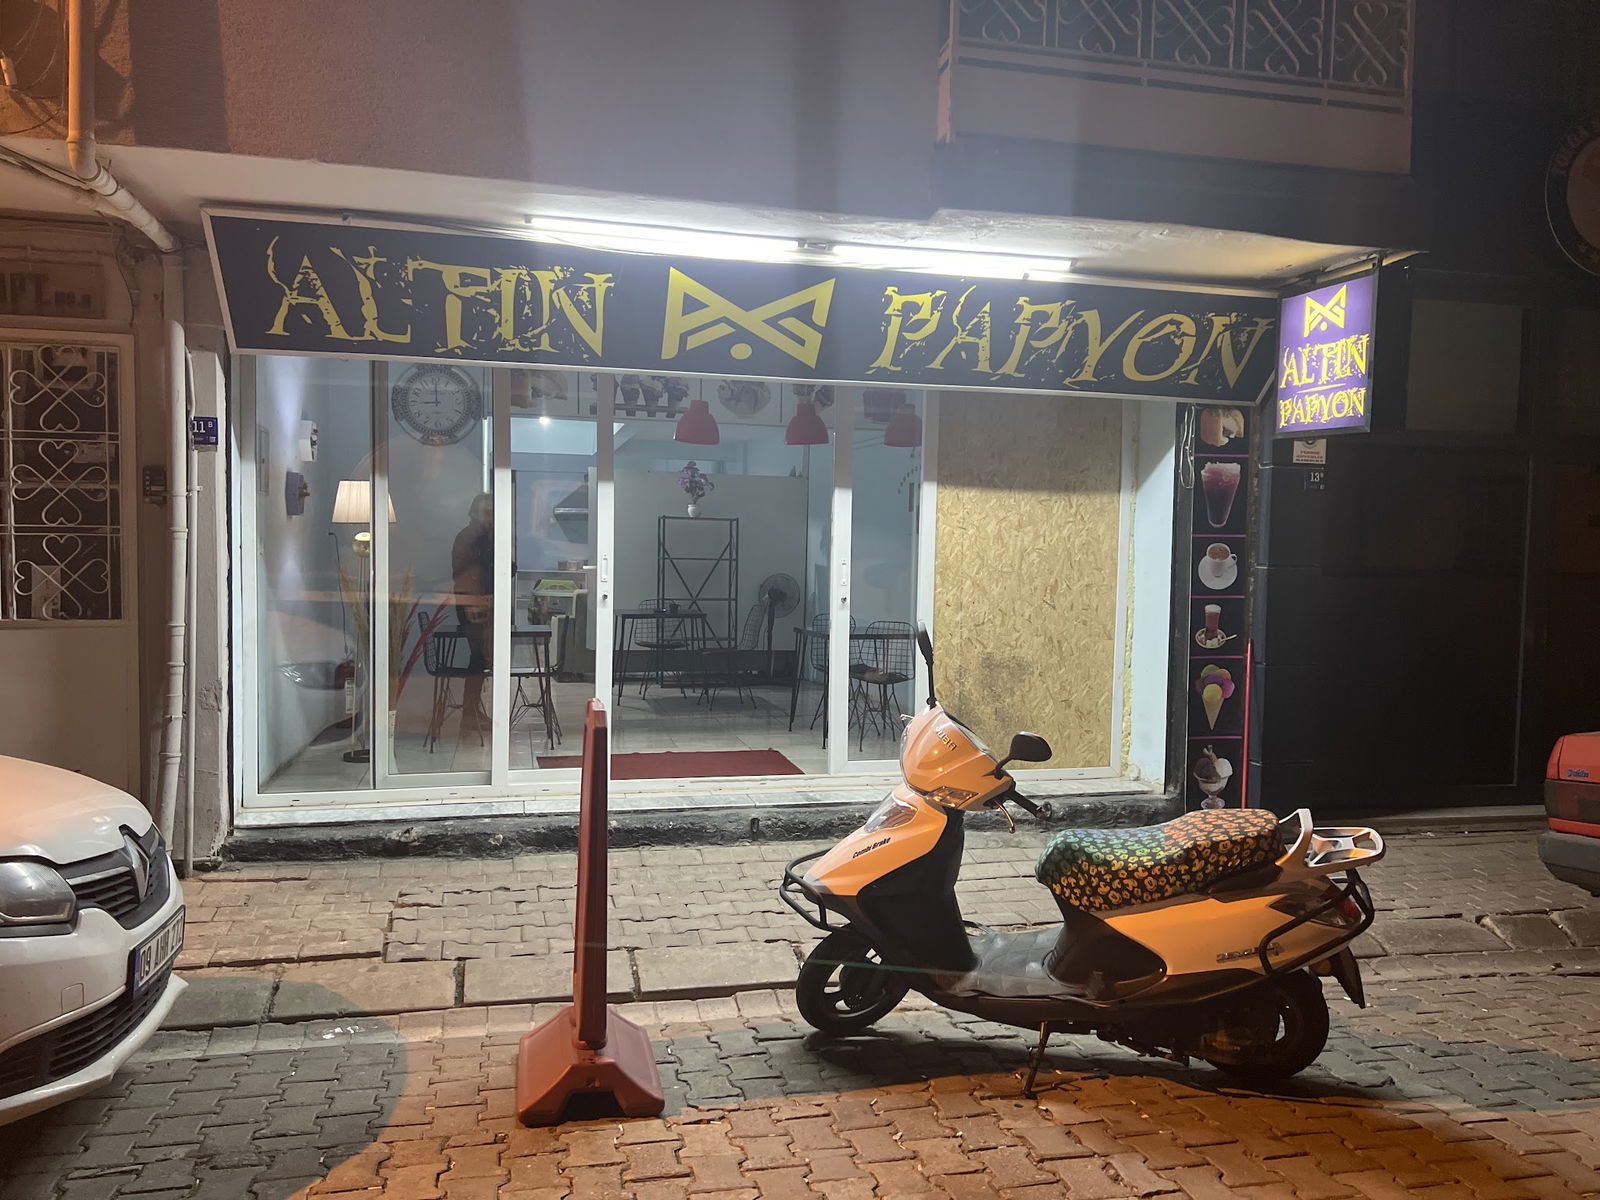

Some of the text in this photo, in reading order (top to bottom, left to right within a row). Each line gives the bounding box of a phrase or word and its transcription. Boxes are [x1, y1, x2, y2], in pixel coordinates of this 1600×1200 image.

[265, 235, 1276, 390] ALTIN PAPYON
[1280, 333, 1370, 388] ALTIN
[1279, 387, 1367, 428] PAPYON
